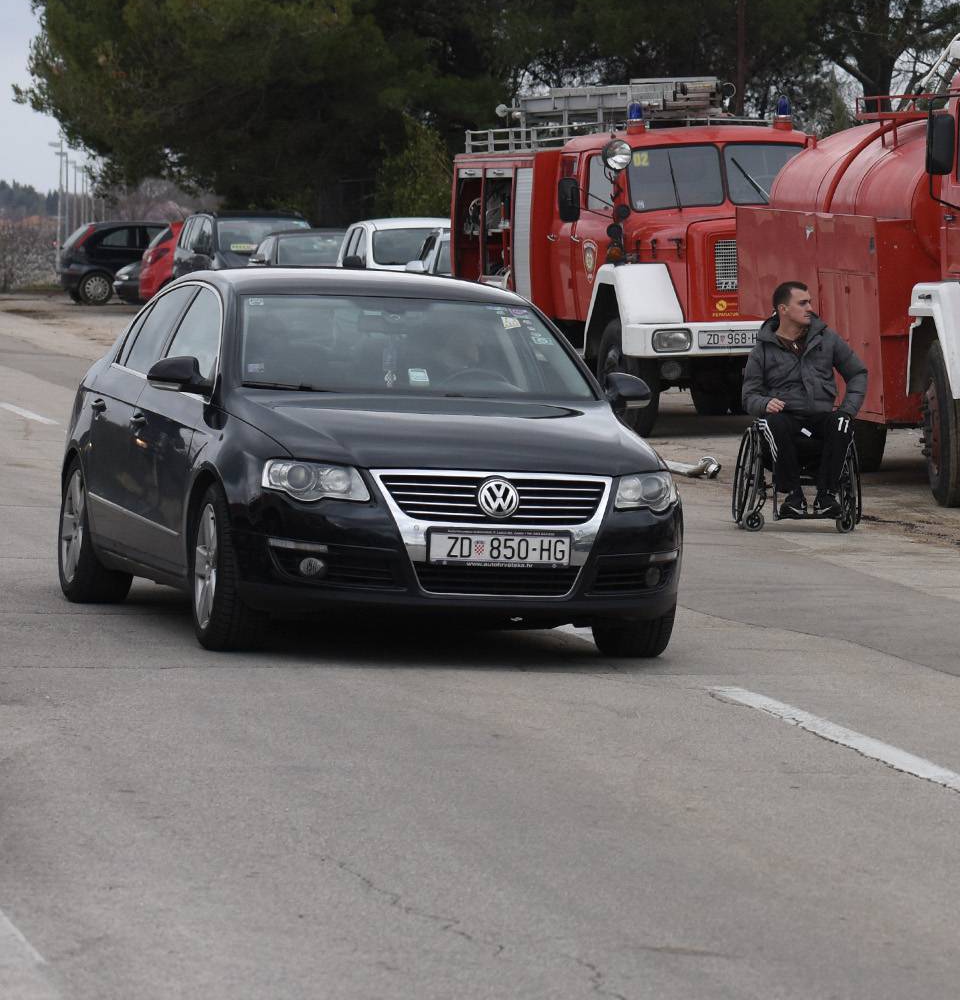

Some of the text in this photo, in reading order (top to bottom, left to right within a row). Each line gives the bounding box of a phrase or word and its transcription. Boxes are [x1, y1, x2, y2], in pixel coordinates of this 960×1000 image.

[707, 333, 719, 345] ZD
[446, 536, 566, 561] ZD 850-HG
